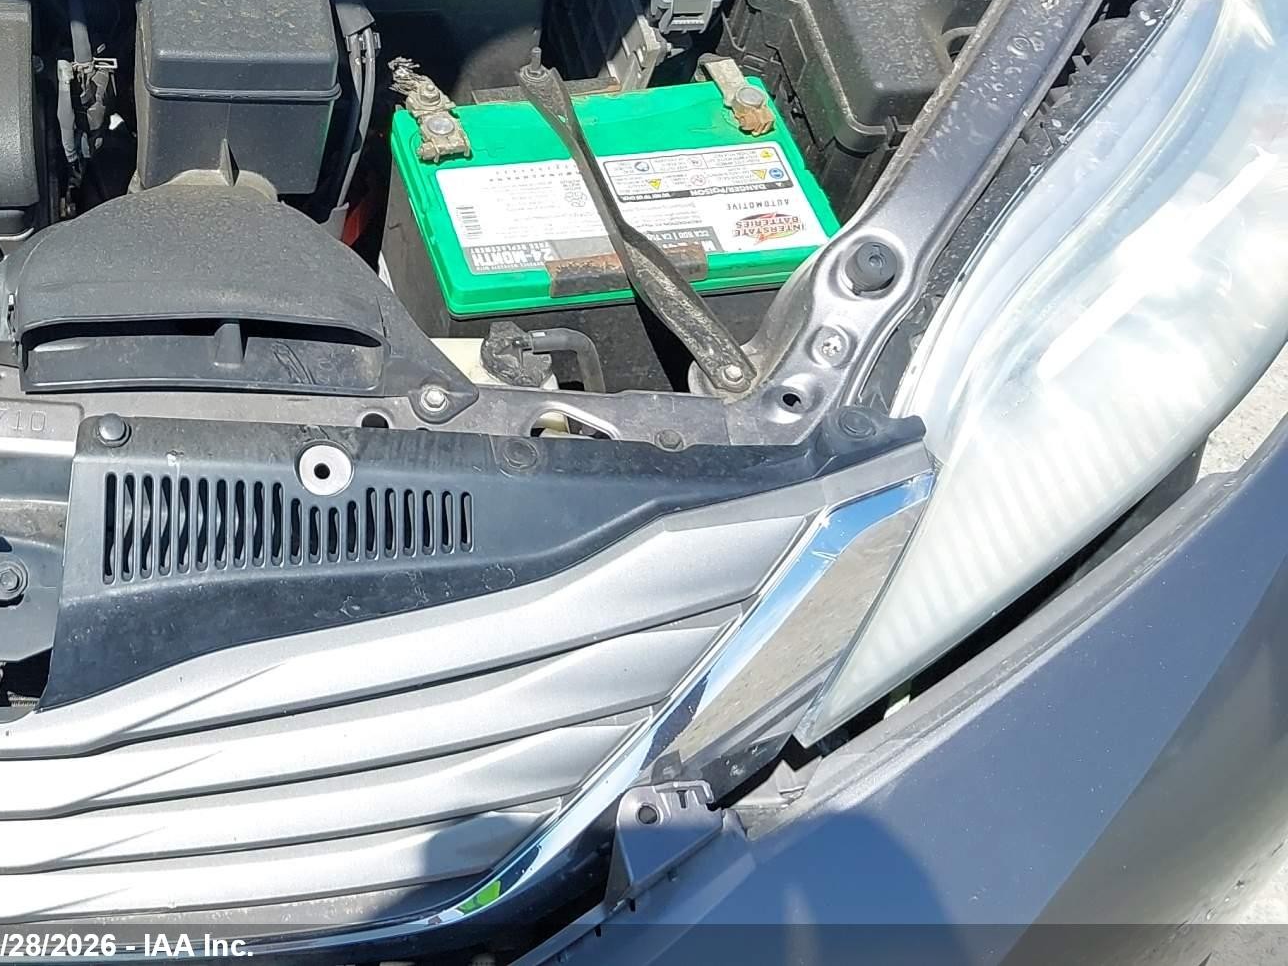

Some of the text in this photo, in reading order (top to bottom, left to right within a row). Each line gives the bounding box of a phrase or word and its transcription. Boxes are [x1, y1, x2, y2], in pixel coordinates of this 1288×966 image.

[690, 184, 766, 196] DANGER/POISON
[726, 199, 789, 211] AUTOMOTIVE
[735, 216, 799, 228] BATTERIES
[734, 224, 805, 237] INTERSTATE
[471, 244, 528, 254] REPLACEMENT
[472, 248, 554, 267] 24-MONTH
